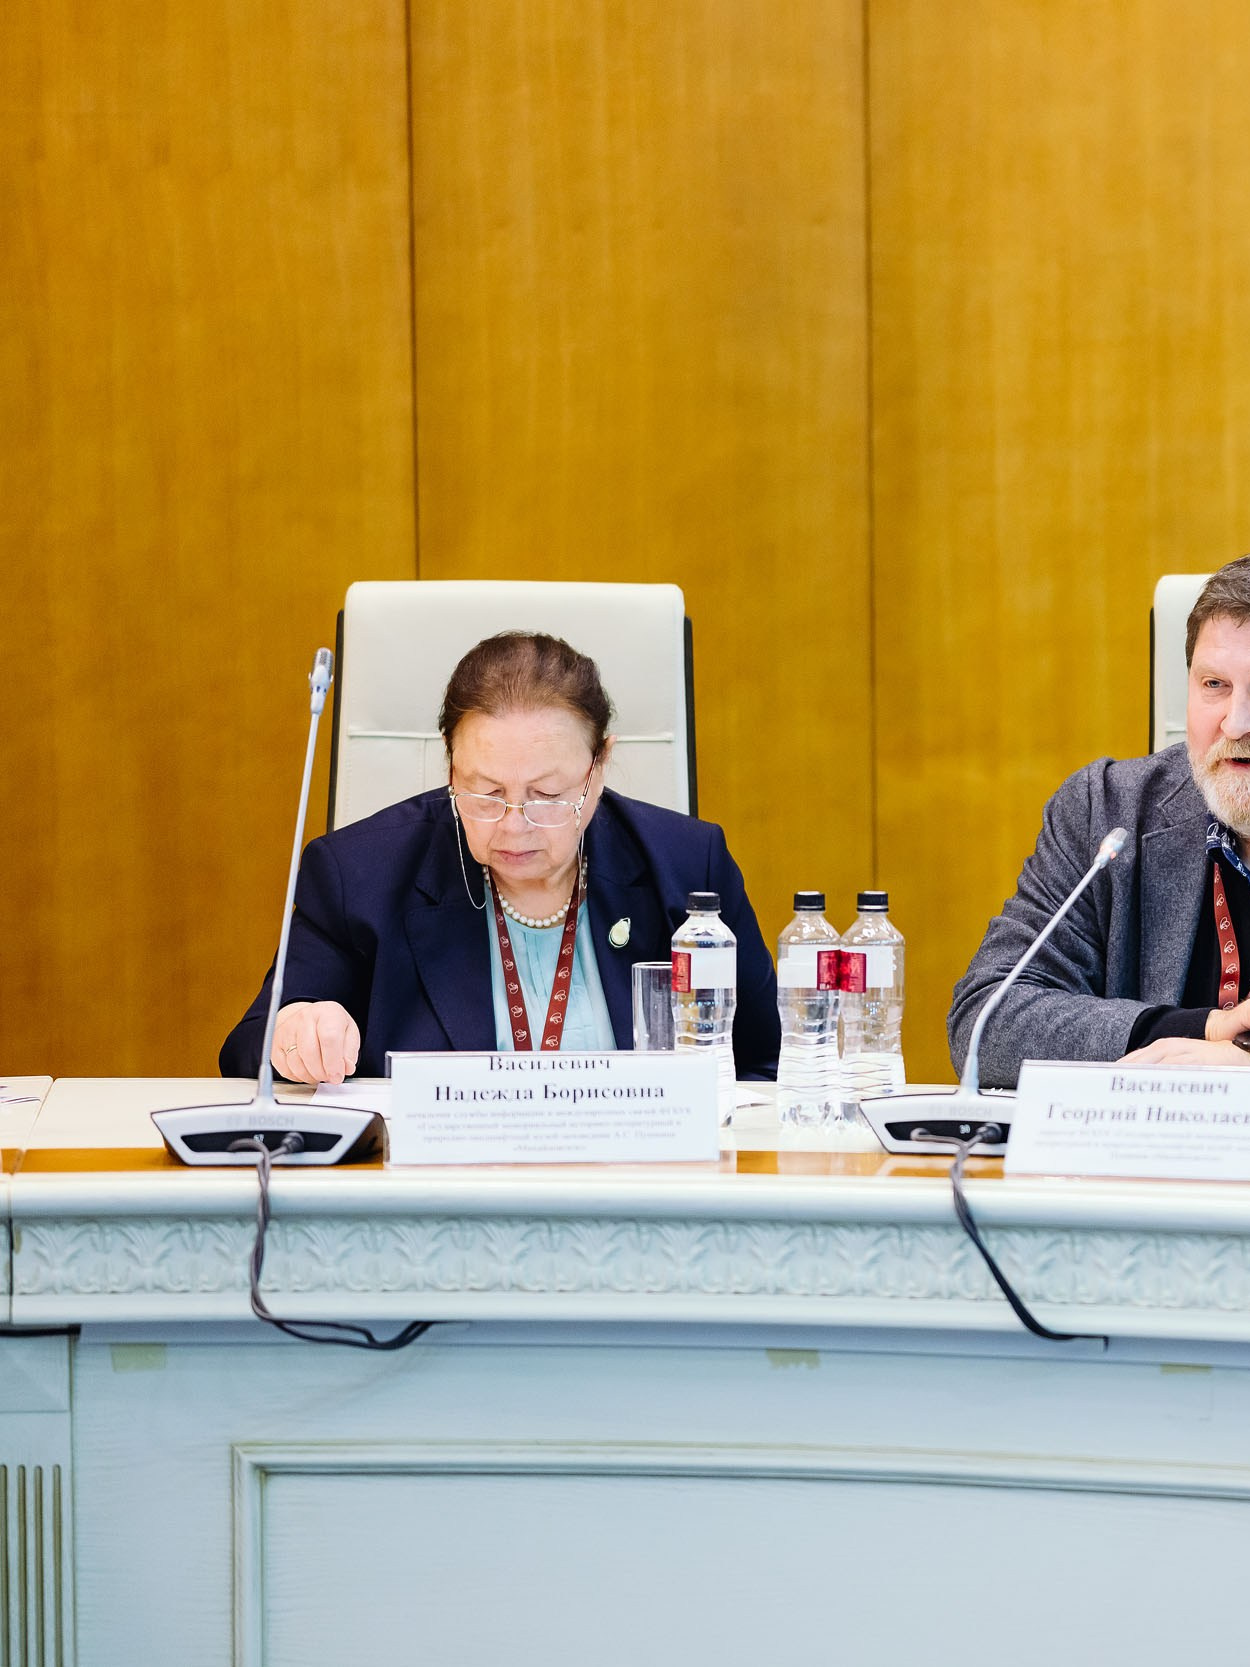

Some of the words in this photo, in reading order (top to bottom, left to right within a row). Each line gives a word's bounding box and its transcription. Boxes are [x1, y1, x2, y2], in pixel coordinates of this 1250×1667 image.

[489, 1055, 611, 1071] Василевич
[435, 1085, 534, 1102] Надежда
[544, 1083, 665, 1103] Борисовна
[1110, 1075, 1231, 1095] Василевич
[248, 1114, 296, 1127] BOSCH
[1047, 1102, 1138, 1125] Георгий
